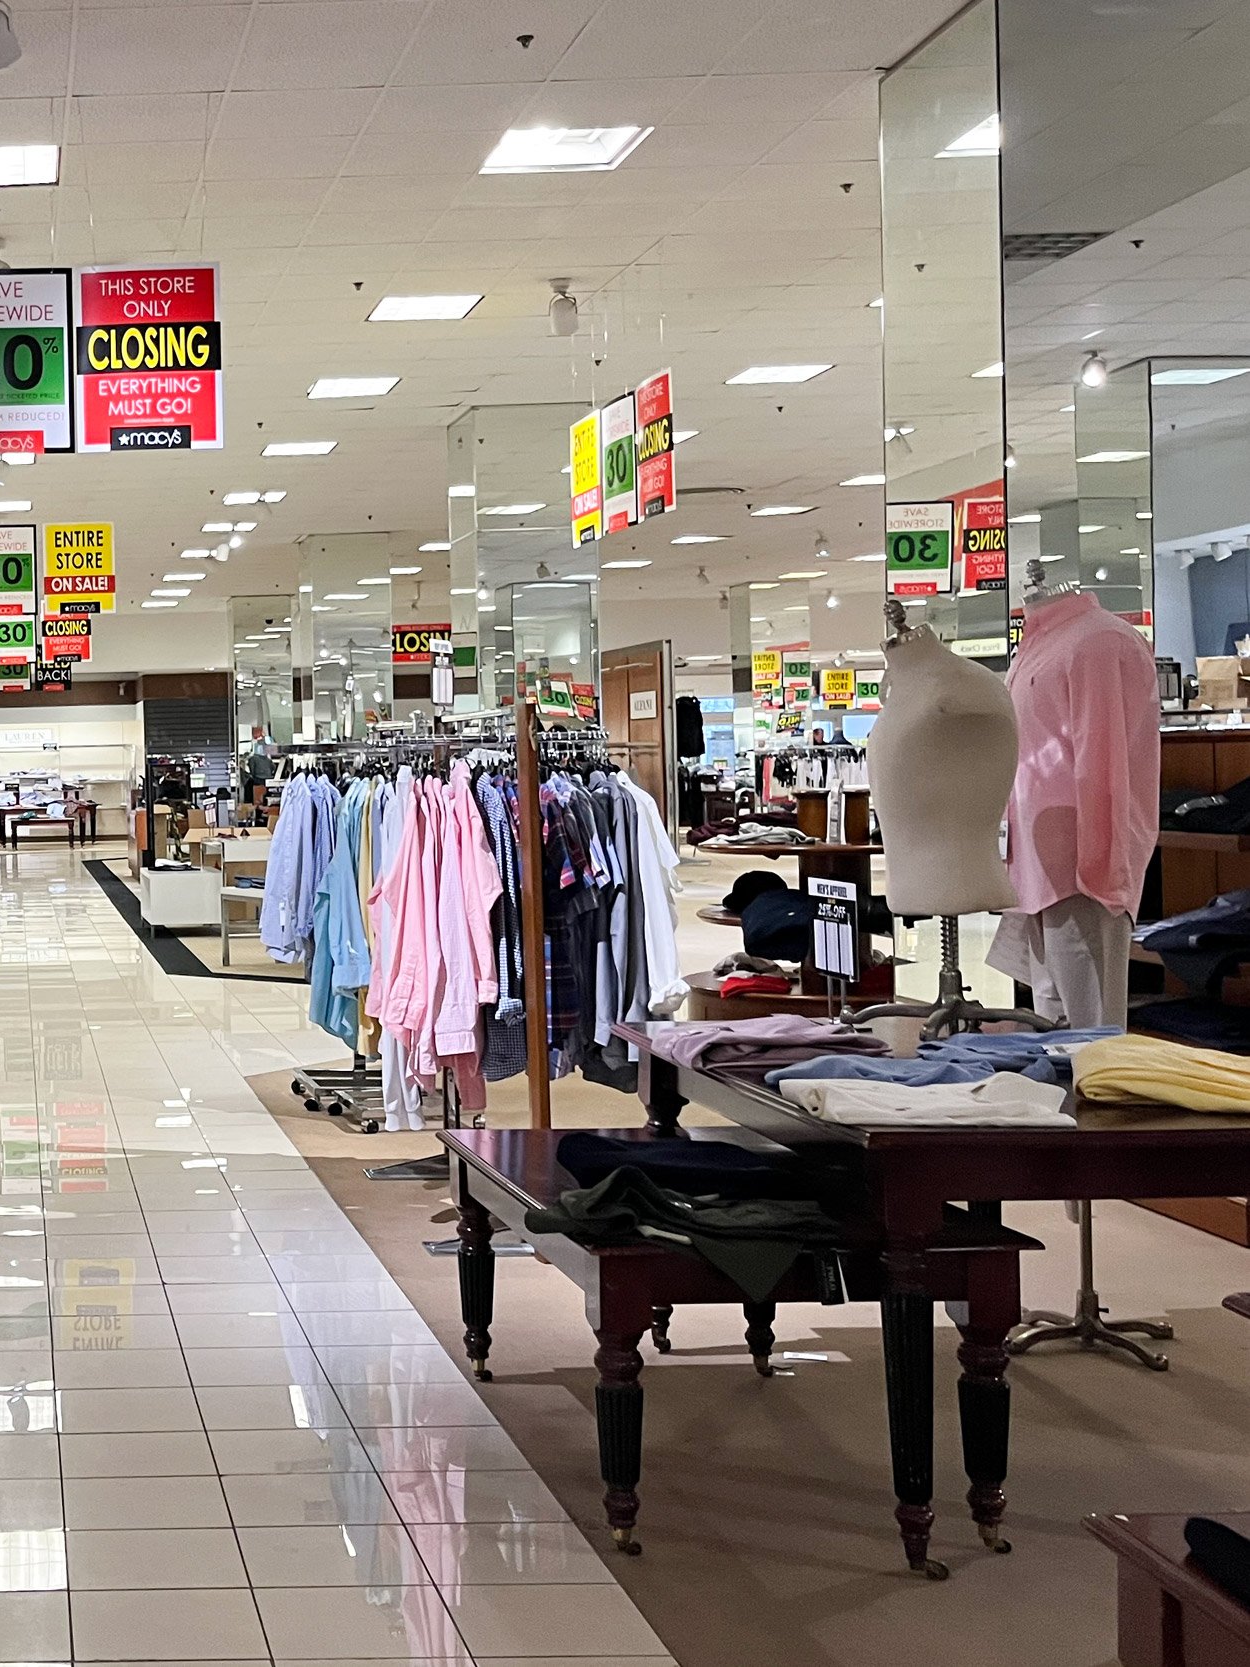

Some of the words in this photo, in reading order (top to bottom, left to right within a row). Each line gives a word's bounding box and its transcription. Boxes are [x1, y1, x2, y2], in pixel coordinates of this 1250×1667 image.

[99, 278, 133, 296] THIS
[138, 277, 195, 295] STORE
[123, 300, 171, 318] ONLY
[88, 325, 210, 371] CLOSING
[98, 377, 201, 396] EVERYTHING
[108, 399, 152, 416] MUST
[156, 398, 191, 414] GO!
[8, 412, 65, 421] REDUCED!
[130, 429, 182, 448] macy's
[638, 418, 670, 461] CLOSING
[55, 530, 103, 548] ENTIRE
[56, 552, 102, 569] STORE
[51, 577, 73, 592] ON
[75, 576, 108, 591] SALE!
[45, 619, 88, 636] CLOSING
[37, 670, 71, 681] BACK!
[827, 672, 849, 681] ENTIRE
[827, 682, 848, 690] STORE
[861, 683, 879, 695] 30
